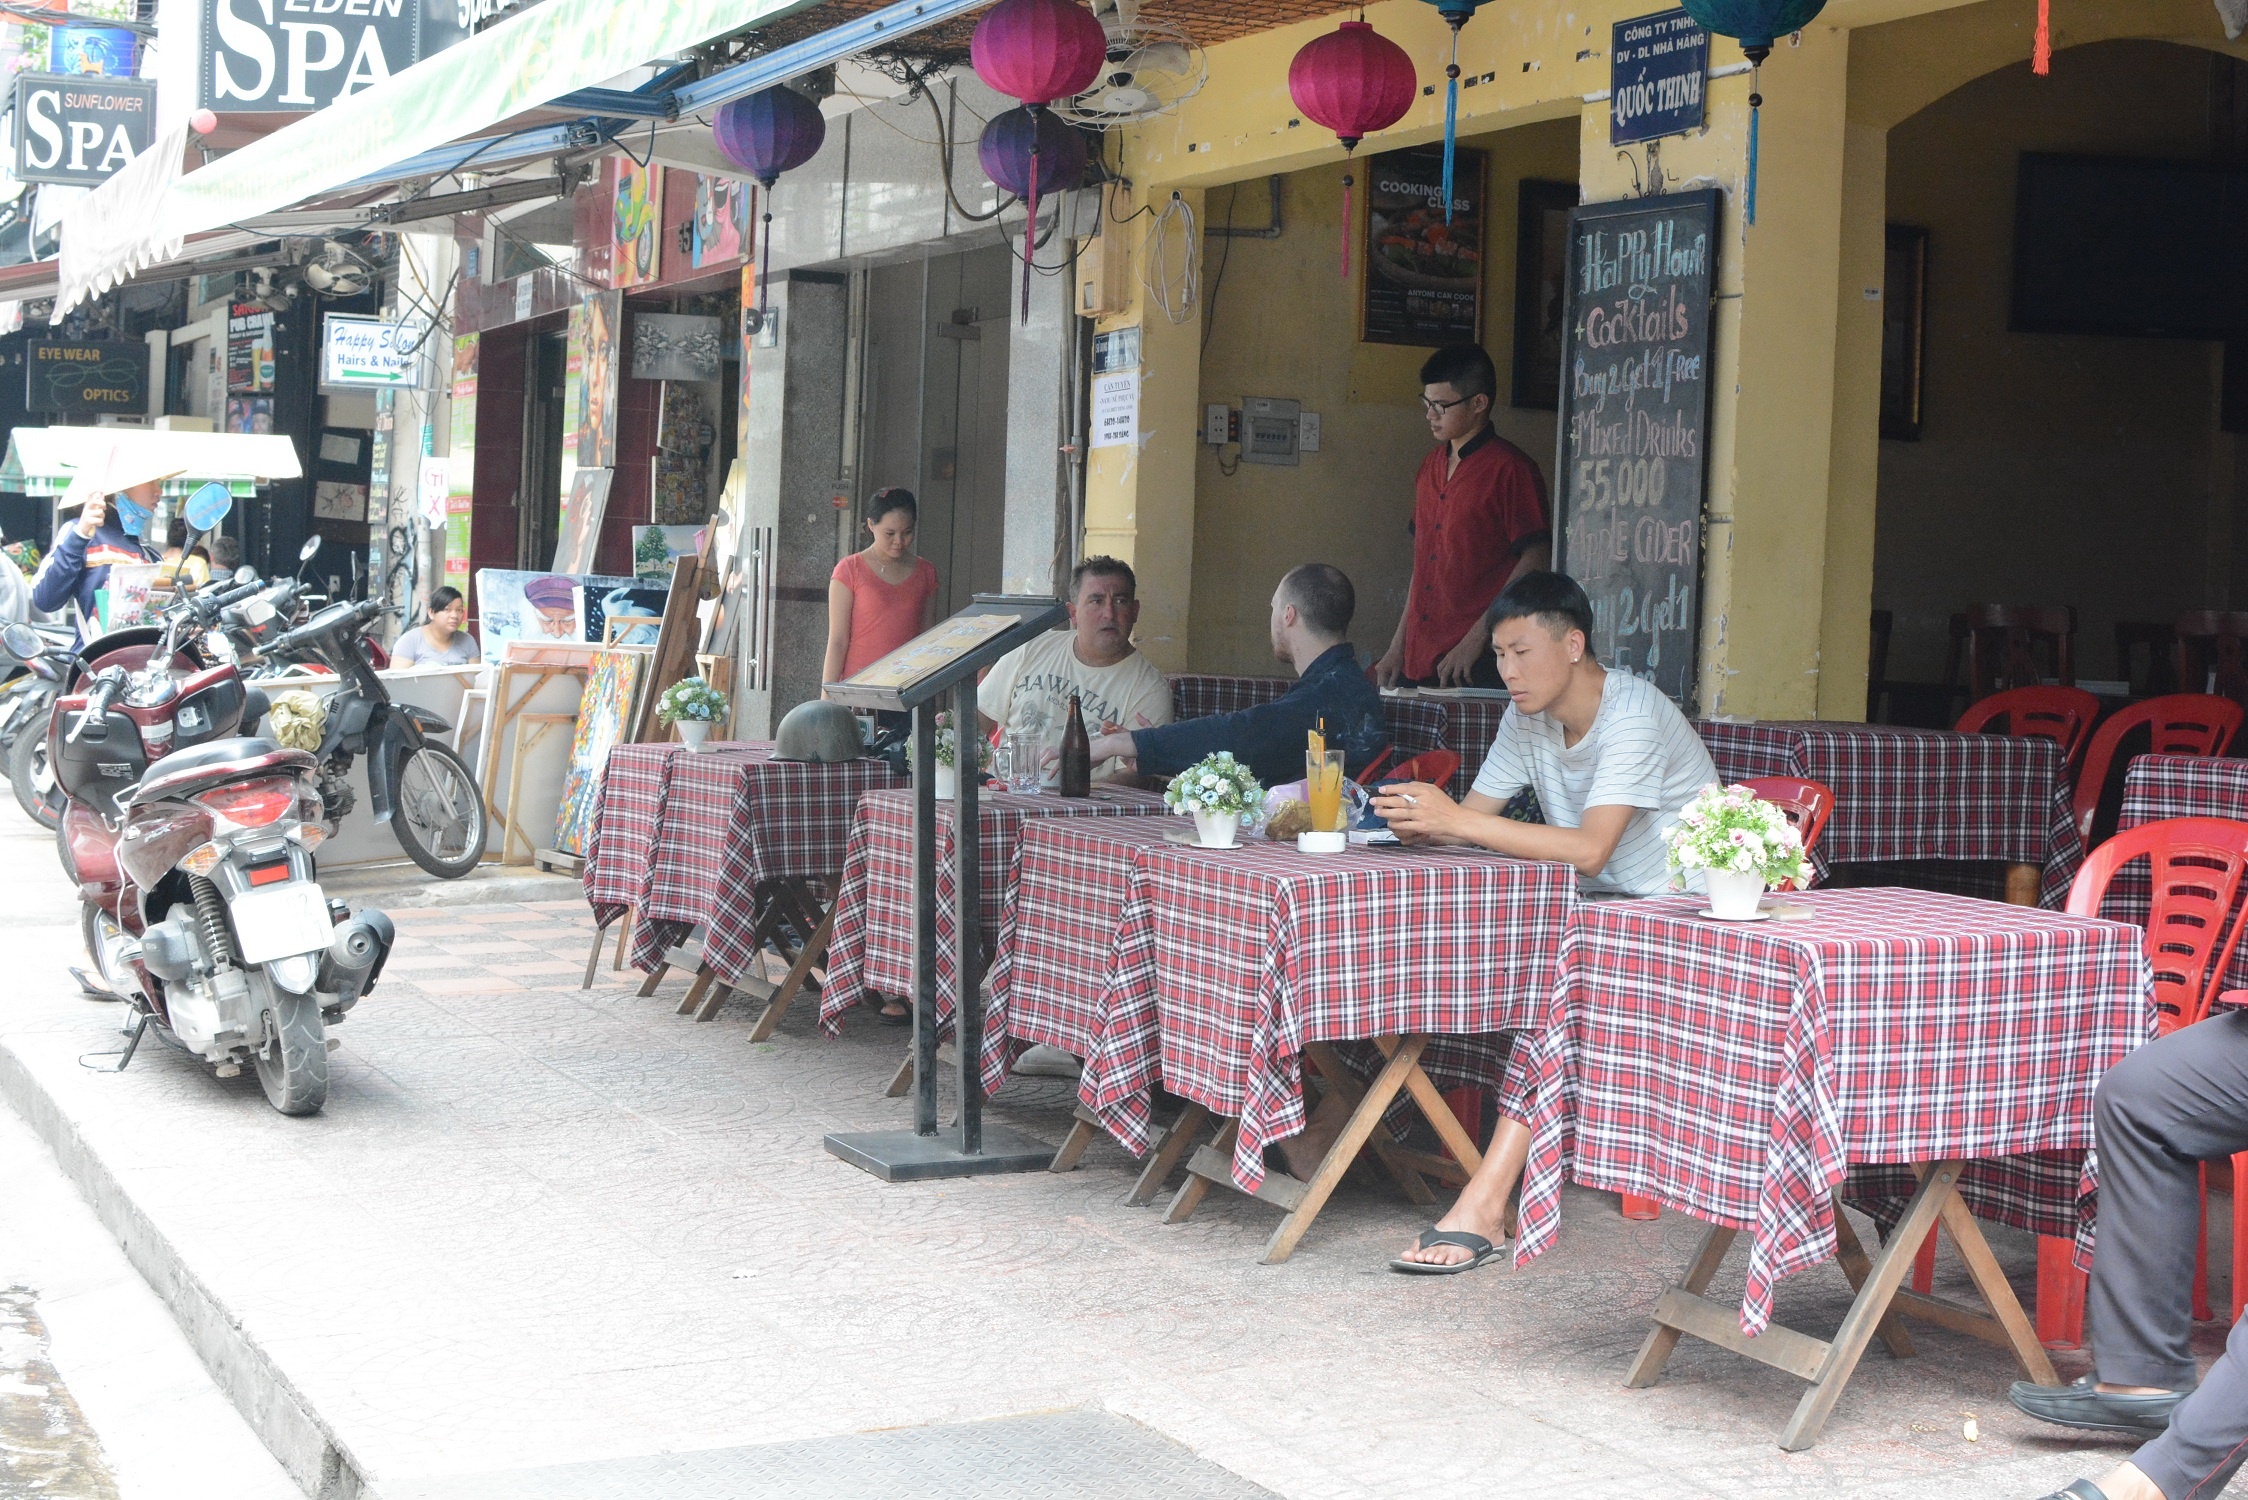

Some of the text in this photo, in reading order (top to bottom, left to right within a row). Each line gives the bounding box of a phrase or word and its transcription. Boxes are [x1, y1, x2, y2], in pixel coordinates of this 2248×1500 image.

[284, 0, 404, 18] EDEN
[1624, 24, 1652, 43] CÔNG
[1655, 22, 1668, 37] TY
[215, 0, 393, 105] SPA
[1616, 49, 1630, 64] DV
[1637, 44, 1651, 59] DL
[1652, 38, 1674, 56] NHÀ
[1675, 32, 1705, 52] HÀNG
[64, 92, 143, 113] SUNFLOWER
[1616, 67, 1702, 127] QUỐC THỊNH
[25, 89, 137, 172] SPA
[1379, 180, 1443, 199] COOKING
[1407, 289, 1435, 298] ANYONE
[1436, 291, 1452, 300] CAN
[1454, 292, 1475, 302] COOK
[229, 312, 275, 333] PUB CRAWL
[334, 326, 375, 352] Happy
[38, 347, 101, 361] EYE WEAR
[338, 354, 367, 367] Hairs
[370, 355, 379, 367] &
[1608, 364, 1622, 395] 2
[82, 388, 130, 403] OPTICS
[1579, 457, 1665, 512] 55.000
[1617, 586, 1642, 636] 2
